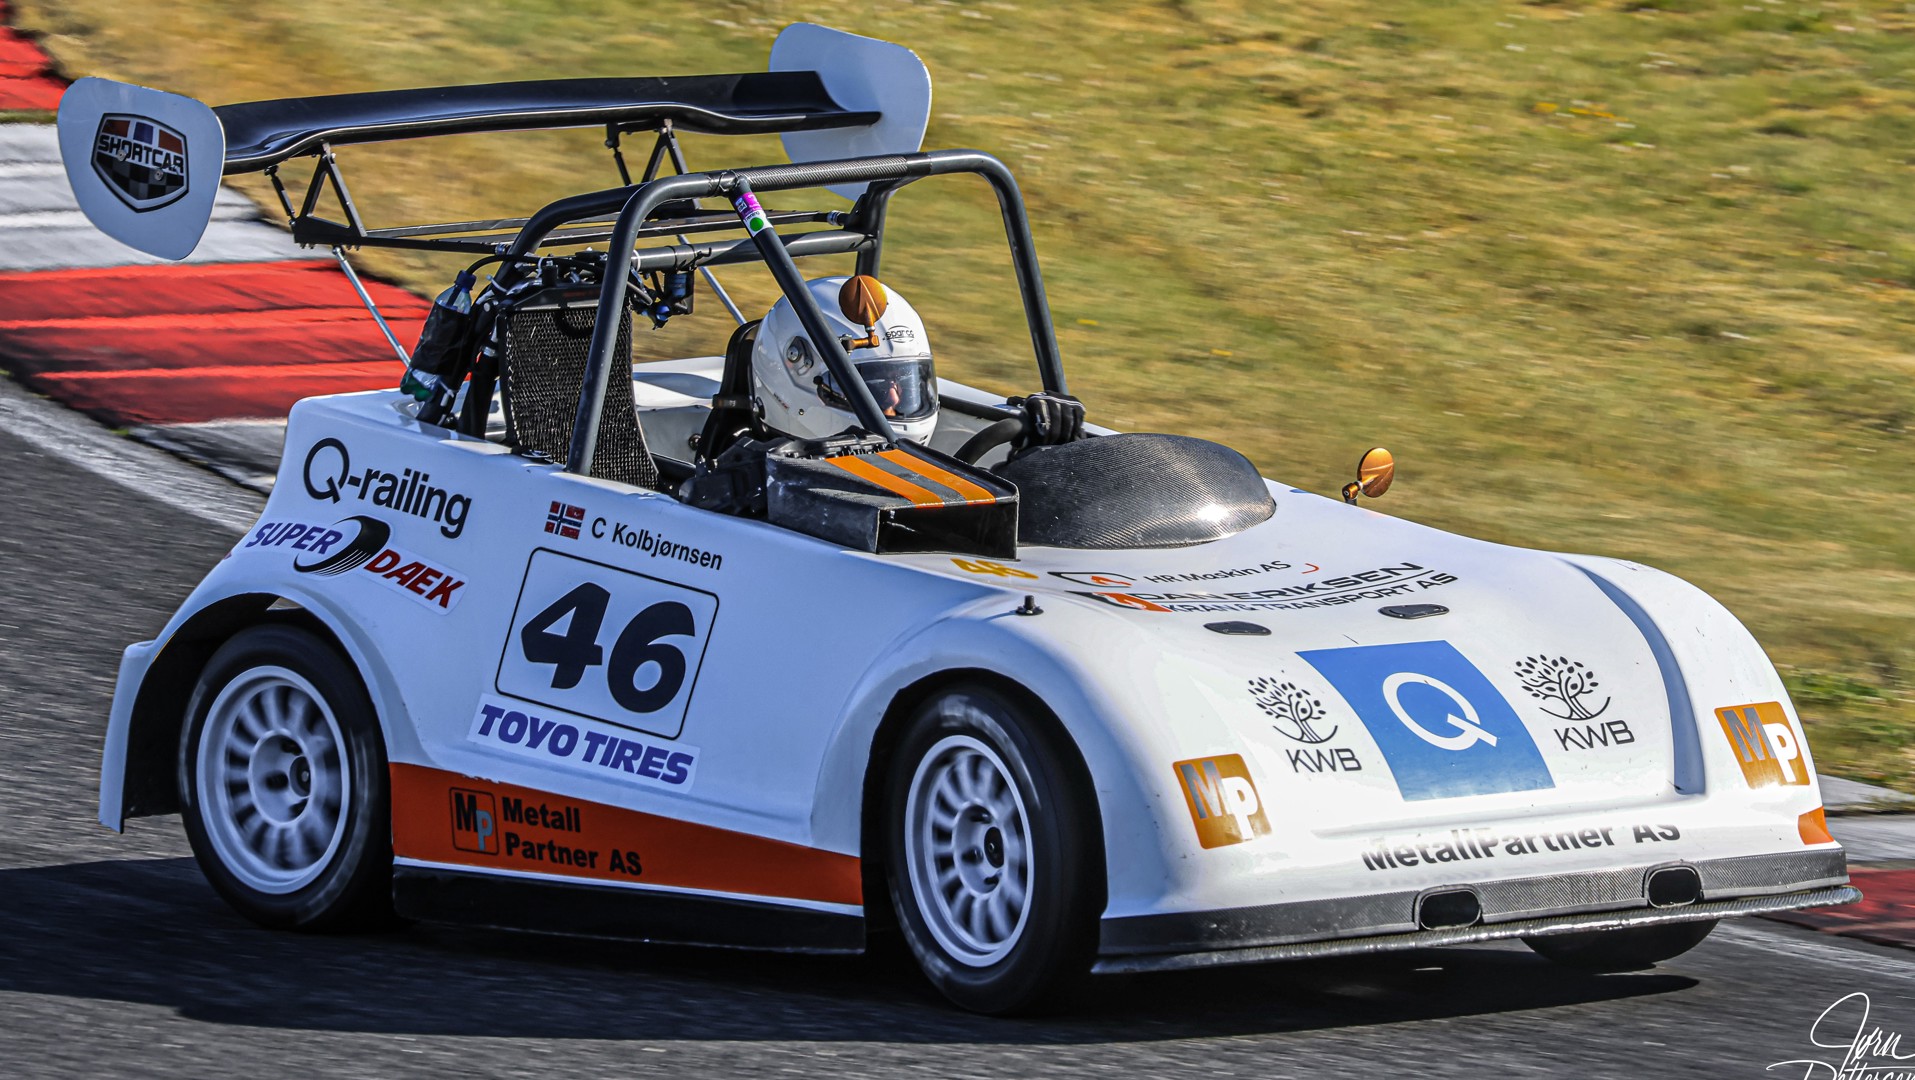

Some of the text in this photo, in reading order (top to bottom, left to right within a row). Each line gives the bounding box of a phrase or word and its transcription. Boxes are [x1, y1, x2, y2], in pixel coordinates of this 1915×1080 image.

[98, 134, 185, 174] SHORTCAR
[303, 437, 472, 539] Q-railing
[245, 522, 343, 555] SUPER
[591, 517, 723, 570] C Kolbjørnsen
[363, 549, 465, 609] DAEK
[1144, 560, 1291, 583] HR Maskin AS
[1224, 562, 1424, 600] ERIKSEN
[1416, 573, 1459, 590] AS
[521, 581, 696, 714] 46
[1382, 672, 1497, 751] Q
[478, 703, 694, 785] TOYO TIRES
[1553, 720, 1635, 751] KWB
[1285, 748, 1362, 773] KWB
[502, 797, 581, 833] Metall
[505, 832, 643, 876] Partner AS
[1360, 824, 1681, 871] MetallPartner AS
